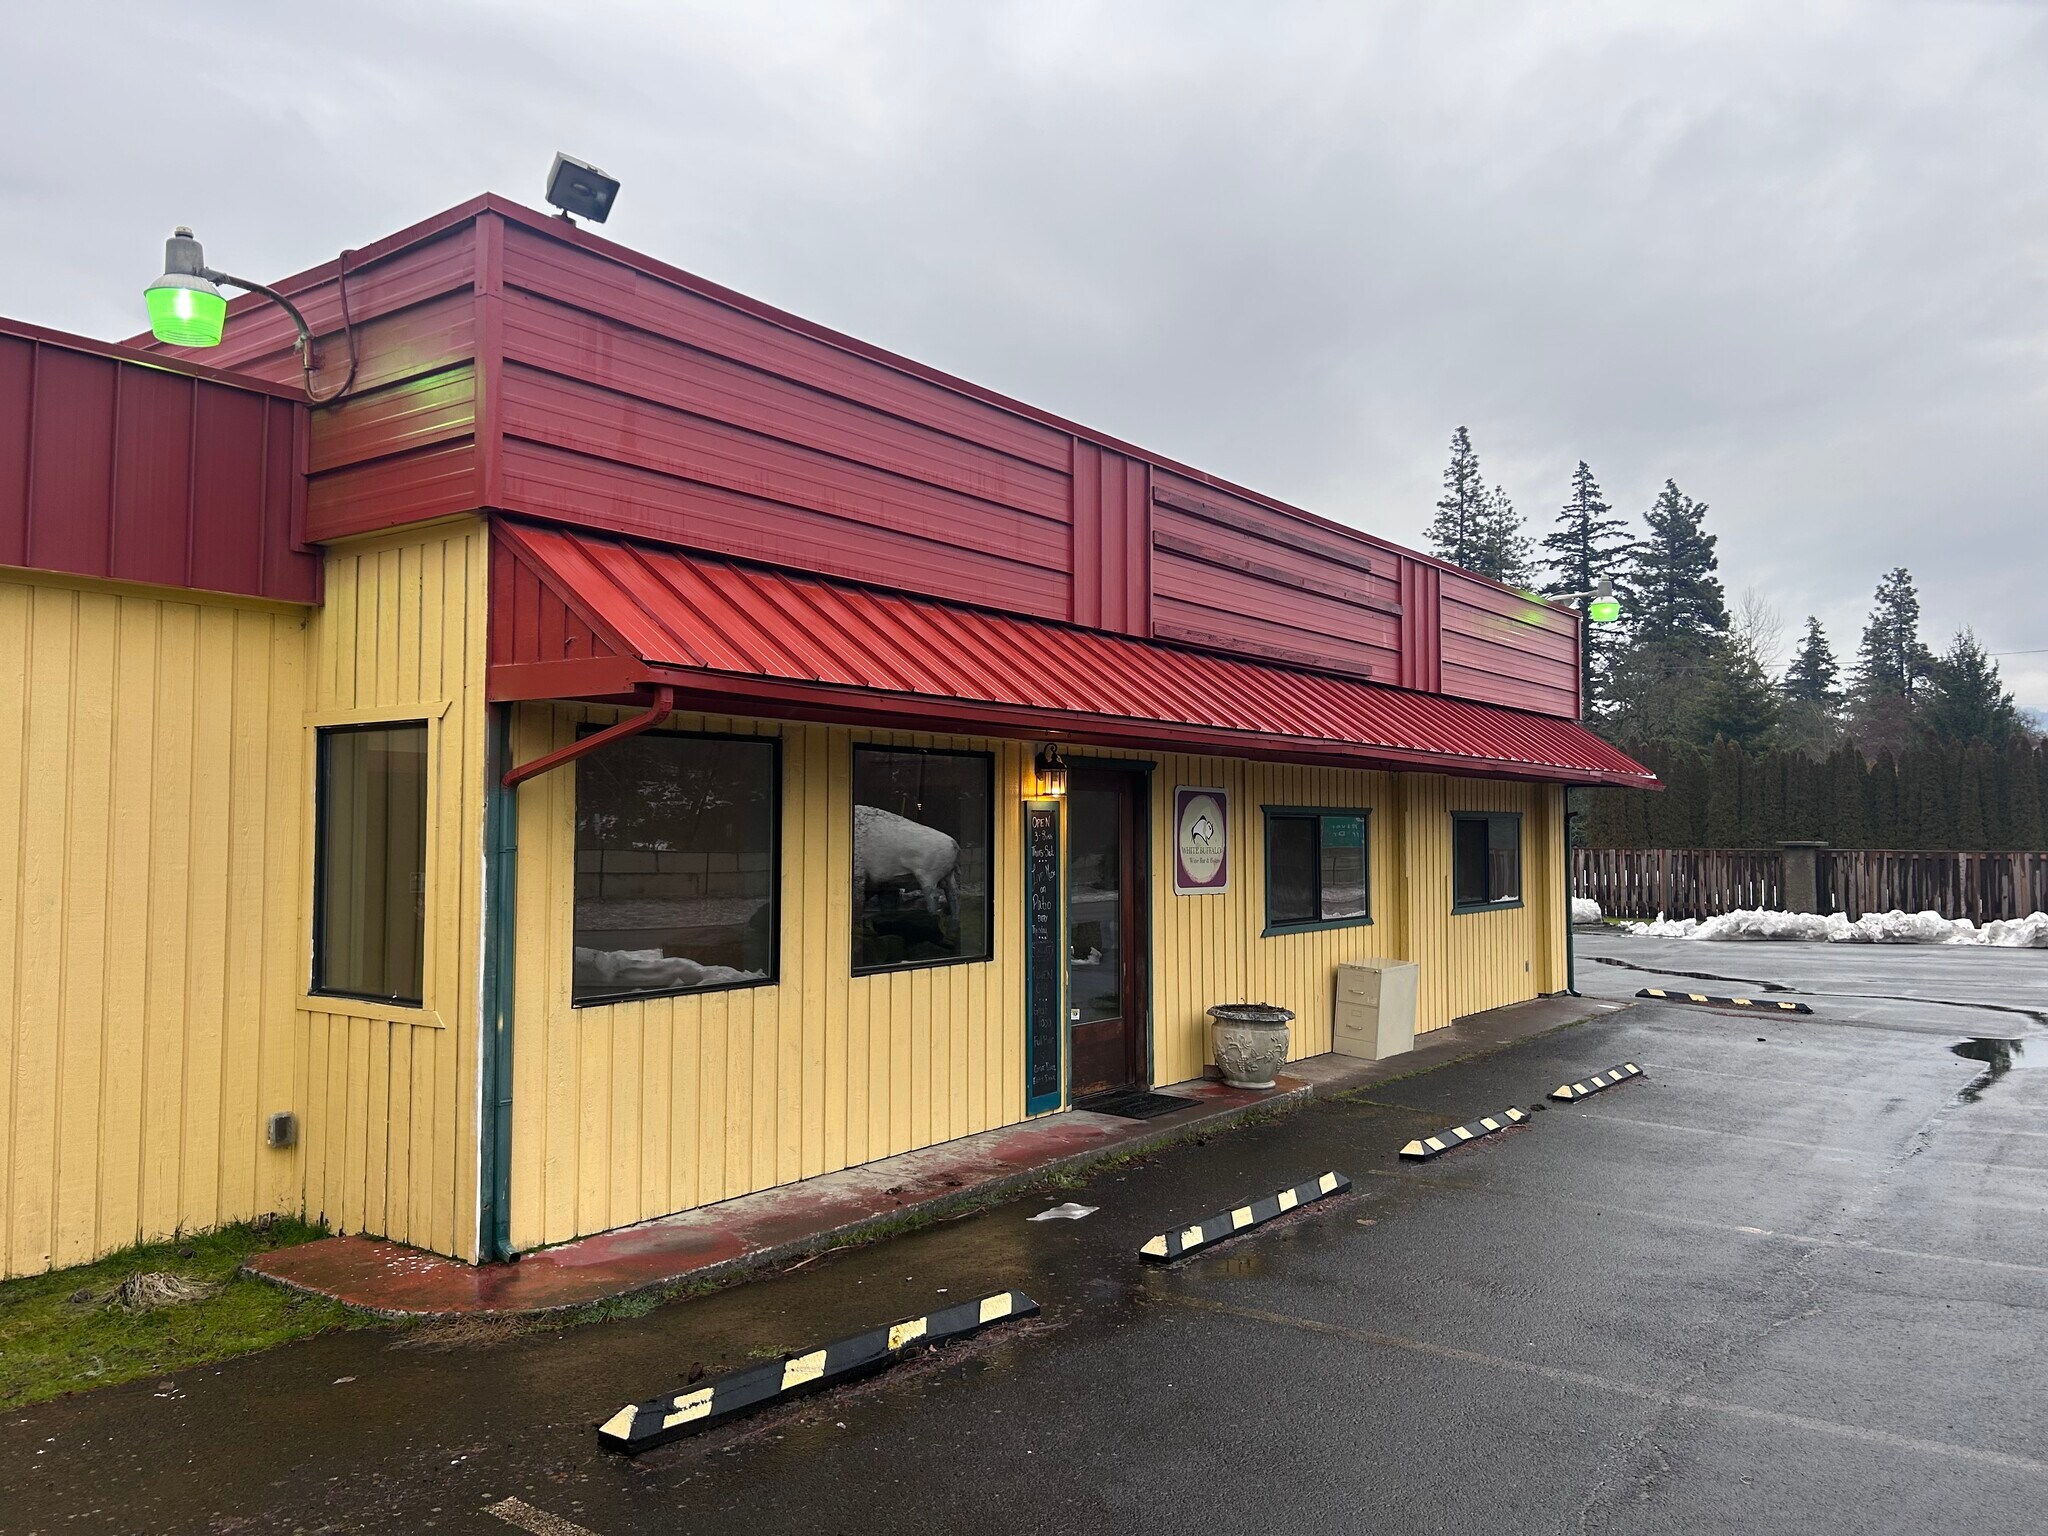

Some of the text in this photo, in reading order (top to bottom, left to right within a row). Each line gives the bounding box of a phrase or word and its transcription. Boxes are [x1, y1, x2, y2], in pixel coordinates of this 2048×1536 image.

[1032, 816, 1051, 828] OPEN
[1039, 886, 1047, 894] on
[1032, 894, 1052, 910] Patio
